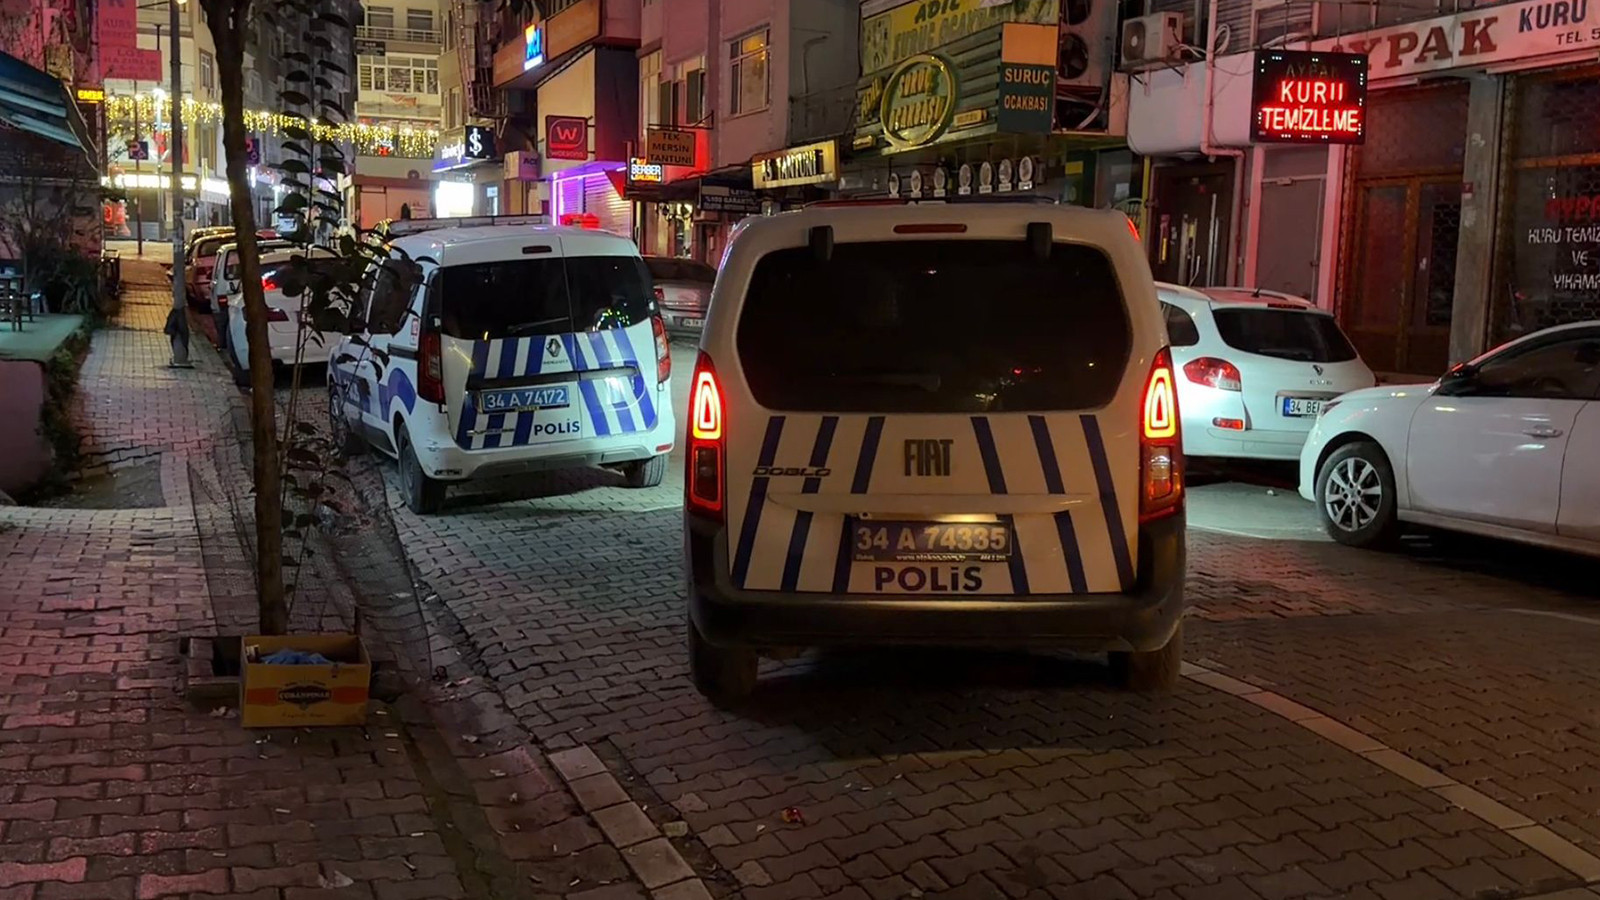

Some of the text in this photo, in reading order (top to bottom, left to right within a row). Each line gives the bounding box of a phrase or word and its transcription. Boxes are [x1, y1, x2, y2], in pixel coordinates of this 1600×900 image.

[1518, 0, 1587, 33] KURU
[1331, 16, 1499, 70] YPAK
[1556, 31, 1587, 45] TEL.
[1005, 68, 1050, 88] SURUÇ
[1004, 94, 1048, 112] OCAKBAŞI
[1261, 105, 1359, 132] TEMİZLEME
[662, 132, 681, 141] TEK
[1528, 228, 1562, 243] KURU
[1571, 250, 1589, 266] VE
[487, 389, 566, 408] 34 A 74172
[1290, 401, 1301, 413] 34
[534, 418, 581, 437] POLİS
[904, 438, 954, 477] FIAT
[752, 466, 831, 477] DOBLO
[857, 526, 1006, 551] 34 A 74335
[874, 566, 983, 592] POLİS
